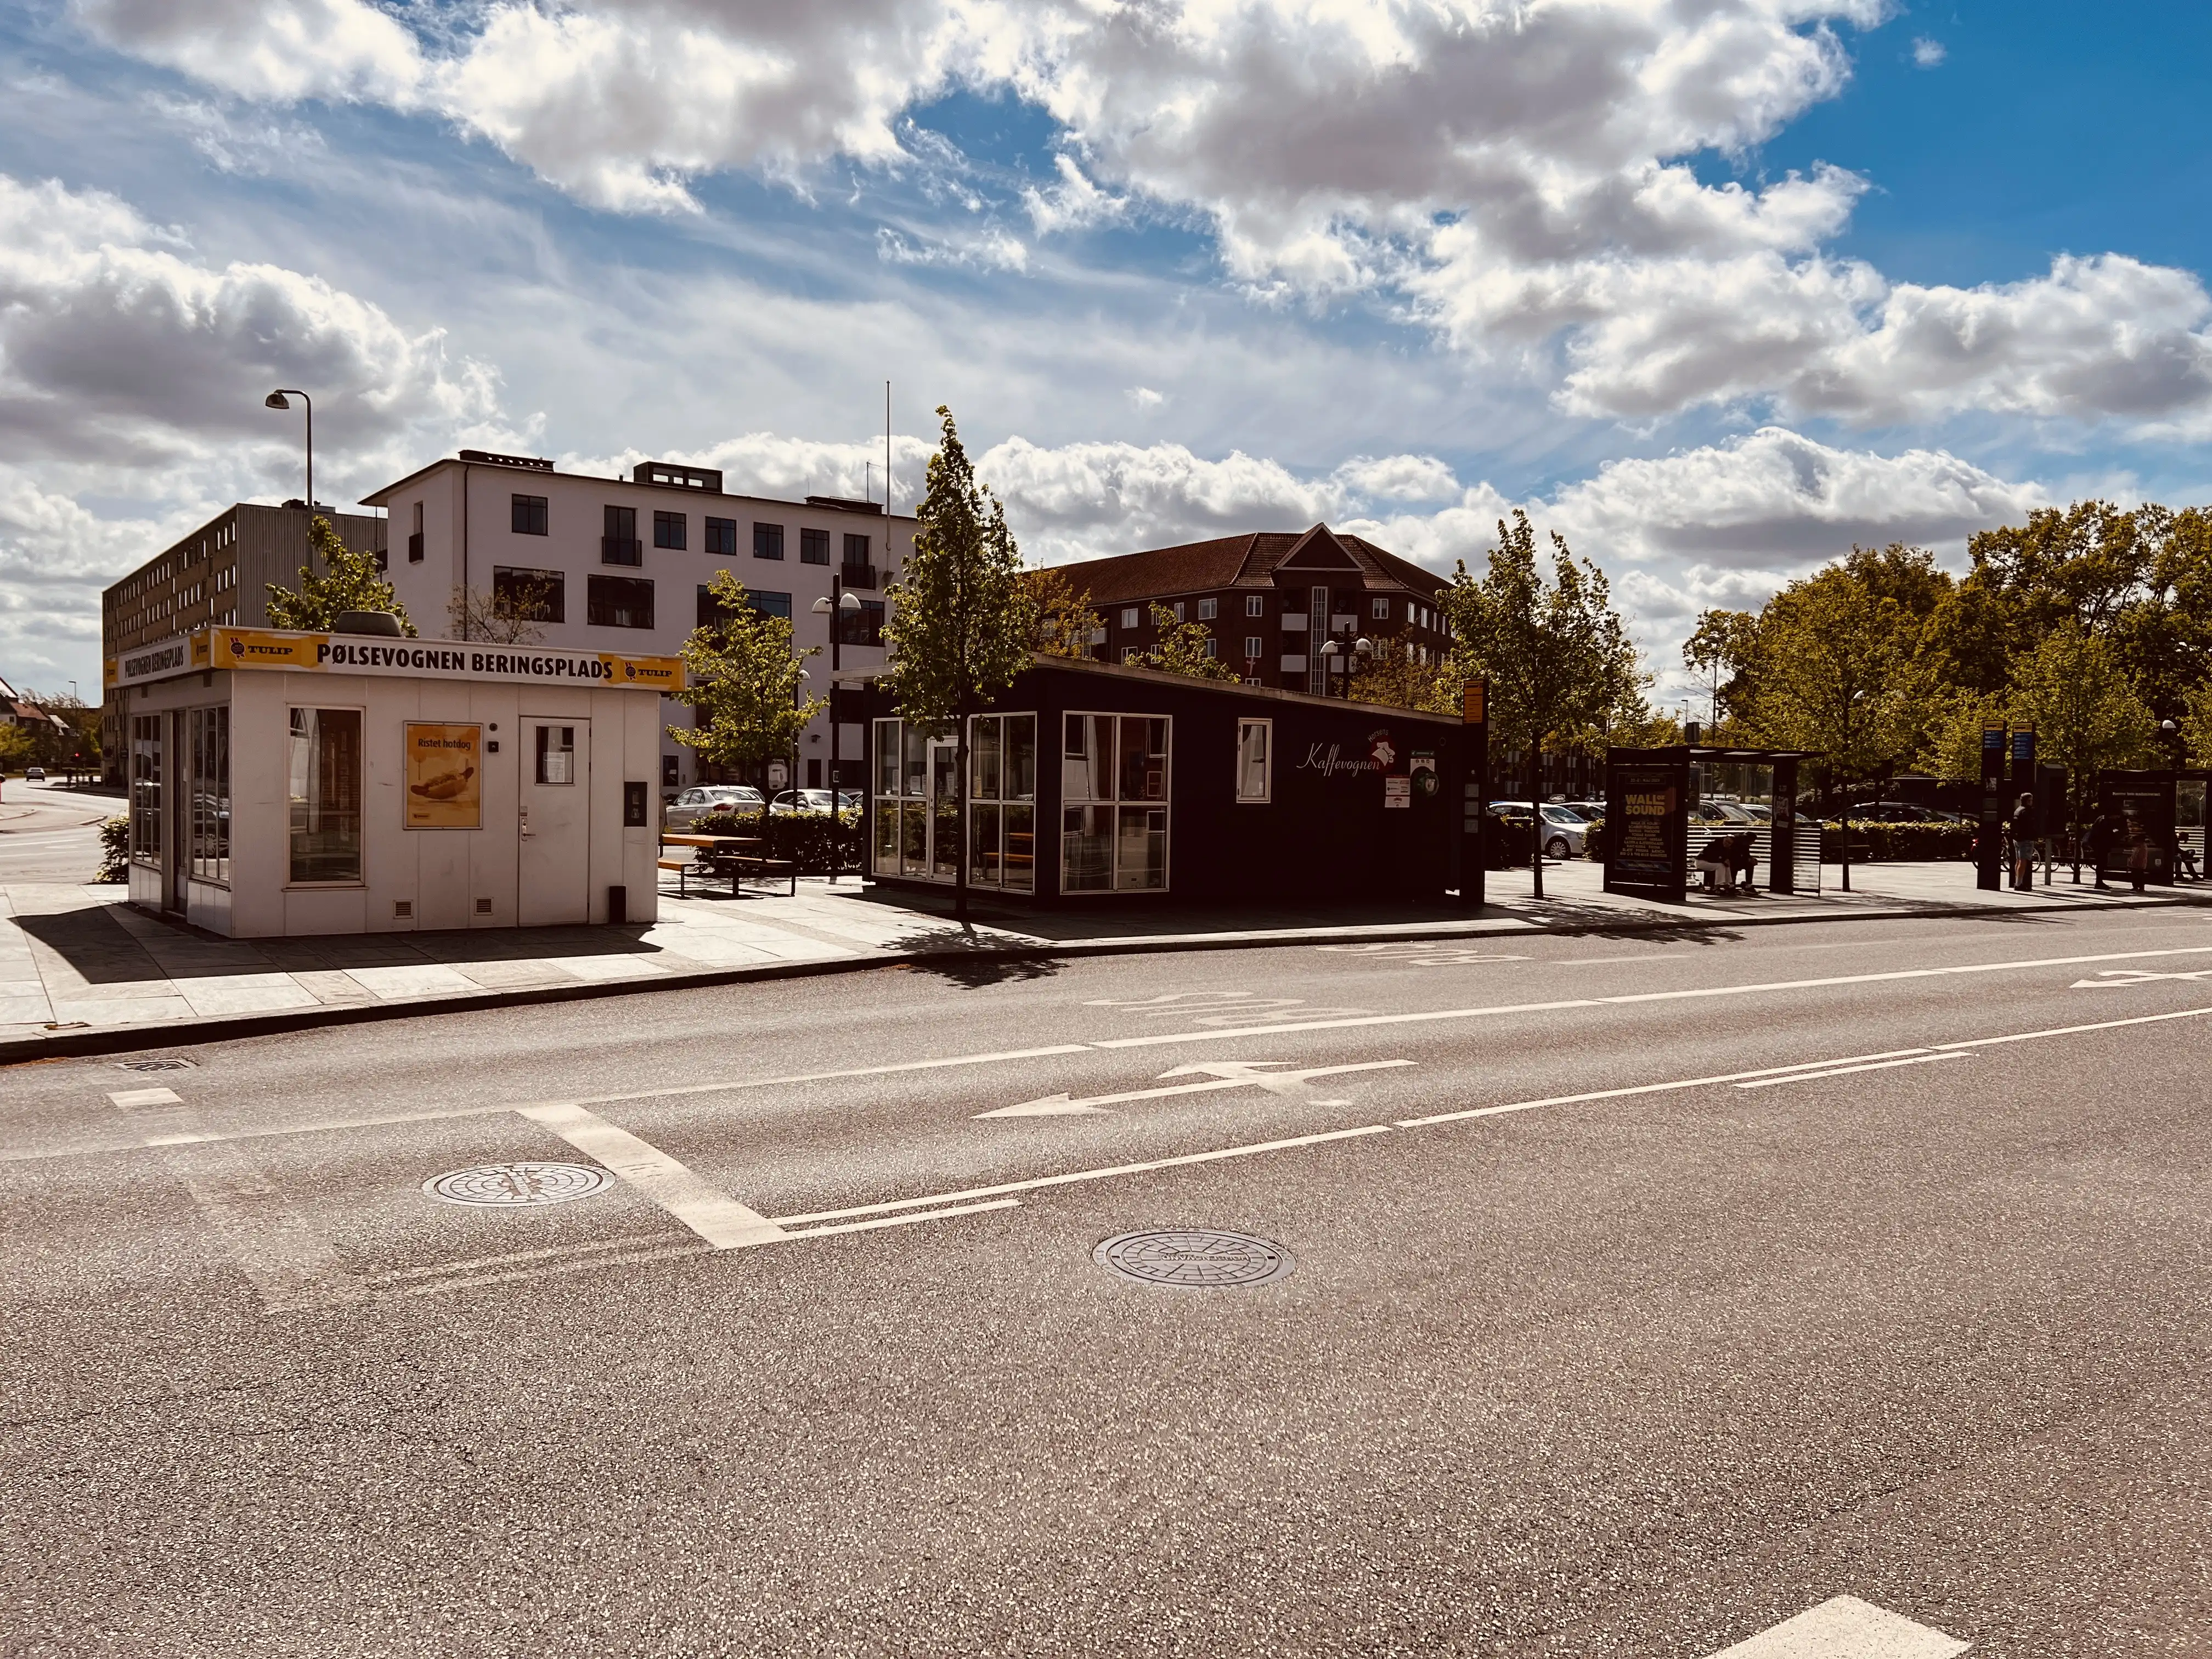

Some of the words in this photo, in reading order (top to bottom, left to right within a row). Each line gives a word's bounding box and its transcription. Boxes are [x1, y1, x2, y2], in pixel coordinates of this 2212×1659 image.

[248, 645, 293, 655] TULIP
[317, 643, 465, 670] PØLSEVOGNEN
[471, 652, 613, 679] BERINGSPLADS
[638, 668, 673, 678] TULIP
[1367, 729, 1389, 743] Horsens
[418, 737, 441, 748] Ristet
[443, 738, 471, 751] hotdog
[1296, 742, 1380, 777] Kaffevognen
[1624, 794, 1665, 805] WALL
[1625, 805, 1665, 815] SOUND
[1316, 944, 1536, 966] BUS
[1082, 992, 1379, 1025] BUS
